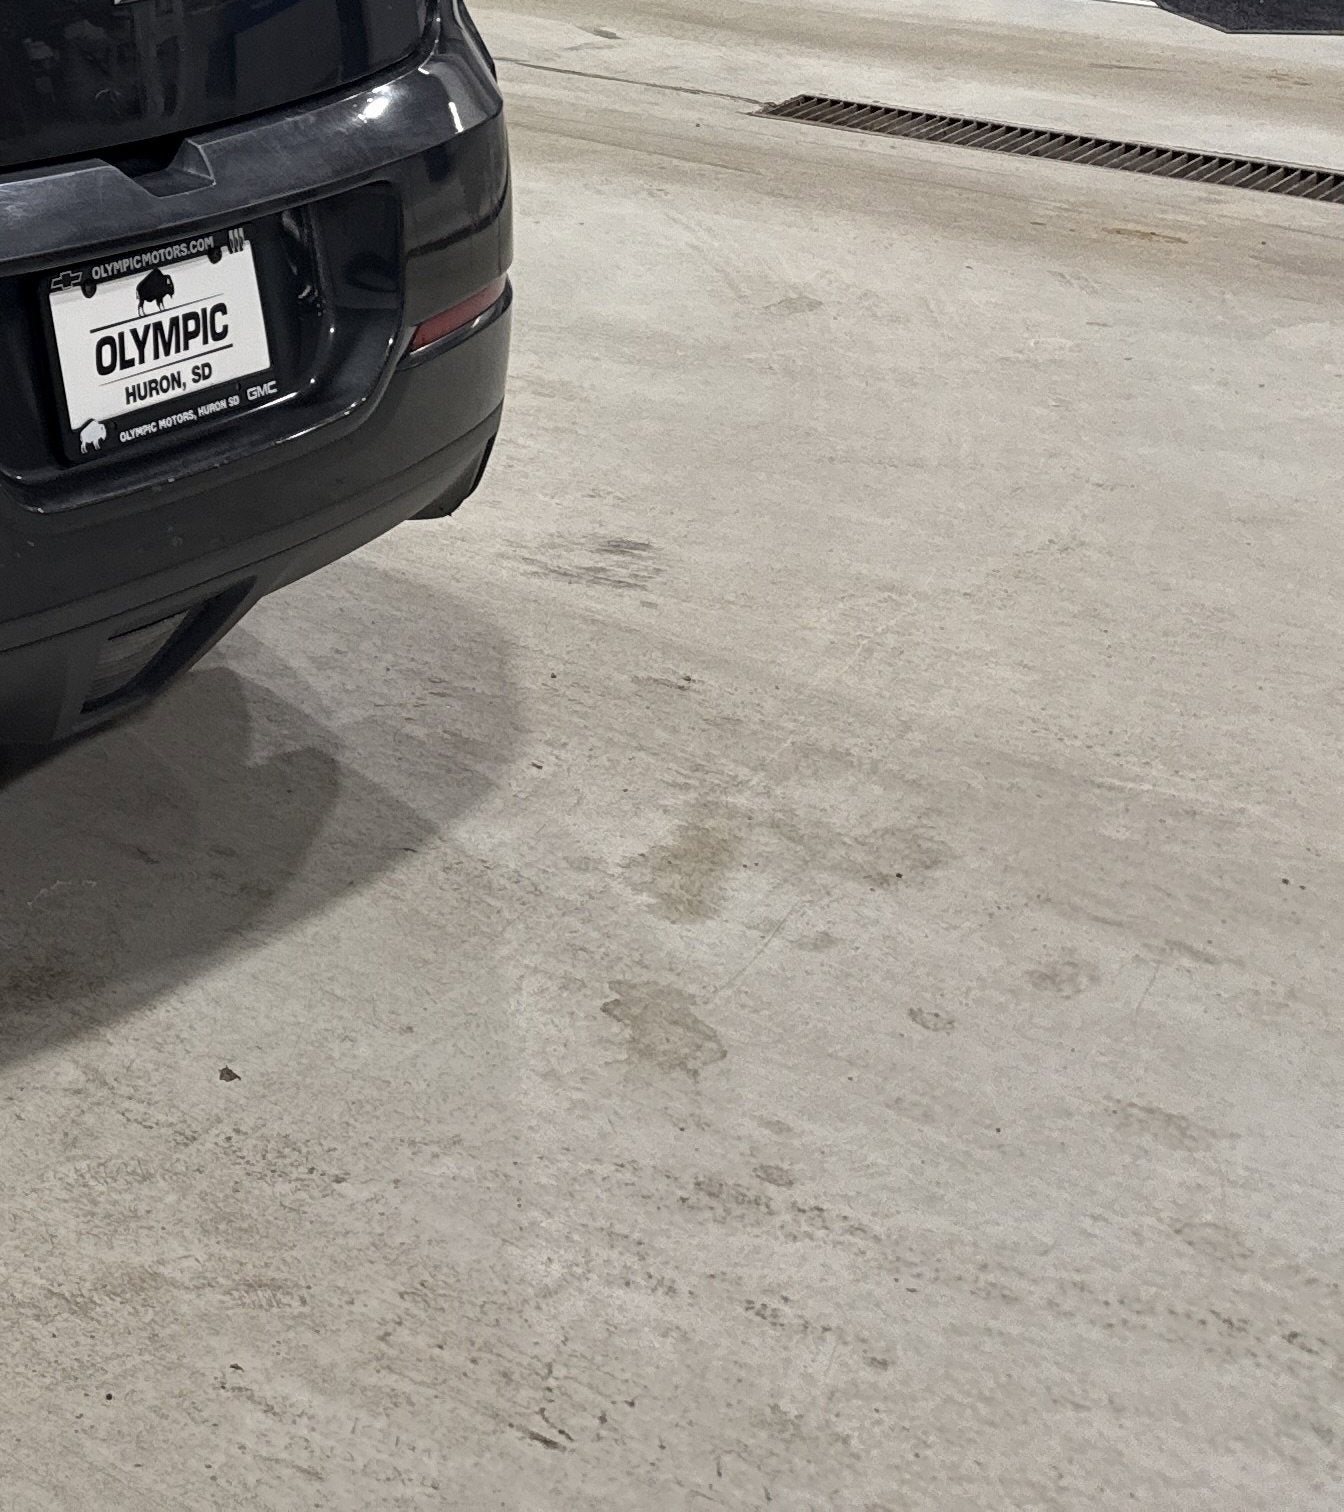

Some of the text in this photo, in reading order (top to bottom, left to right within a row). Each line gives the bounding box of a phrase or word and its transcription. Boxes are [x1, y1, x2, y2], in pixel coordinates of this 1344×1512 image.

[91, 235, 215, 280] OLYMPICMOTORS.COM
[94, 301, 230, 377] OLYMPIC
[124, 362, 214, 405] HURON, SD
[246, 380, 278, 401] GMC
[119, 395, 241, 443] OLYMPIC MOTORS, HURON SD
